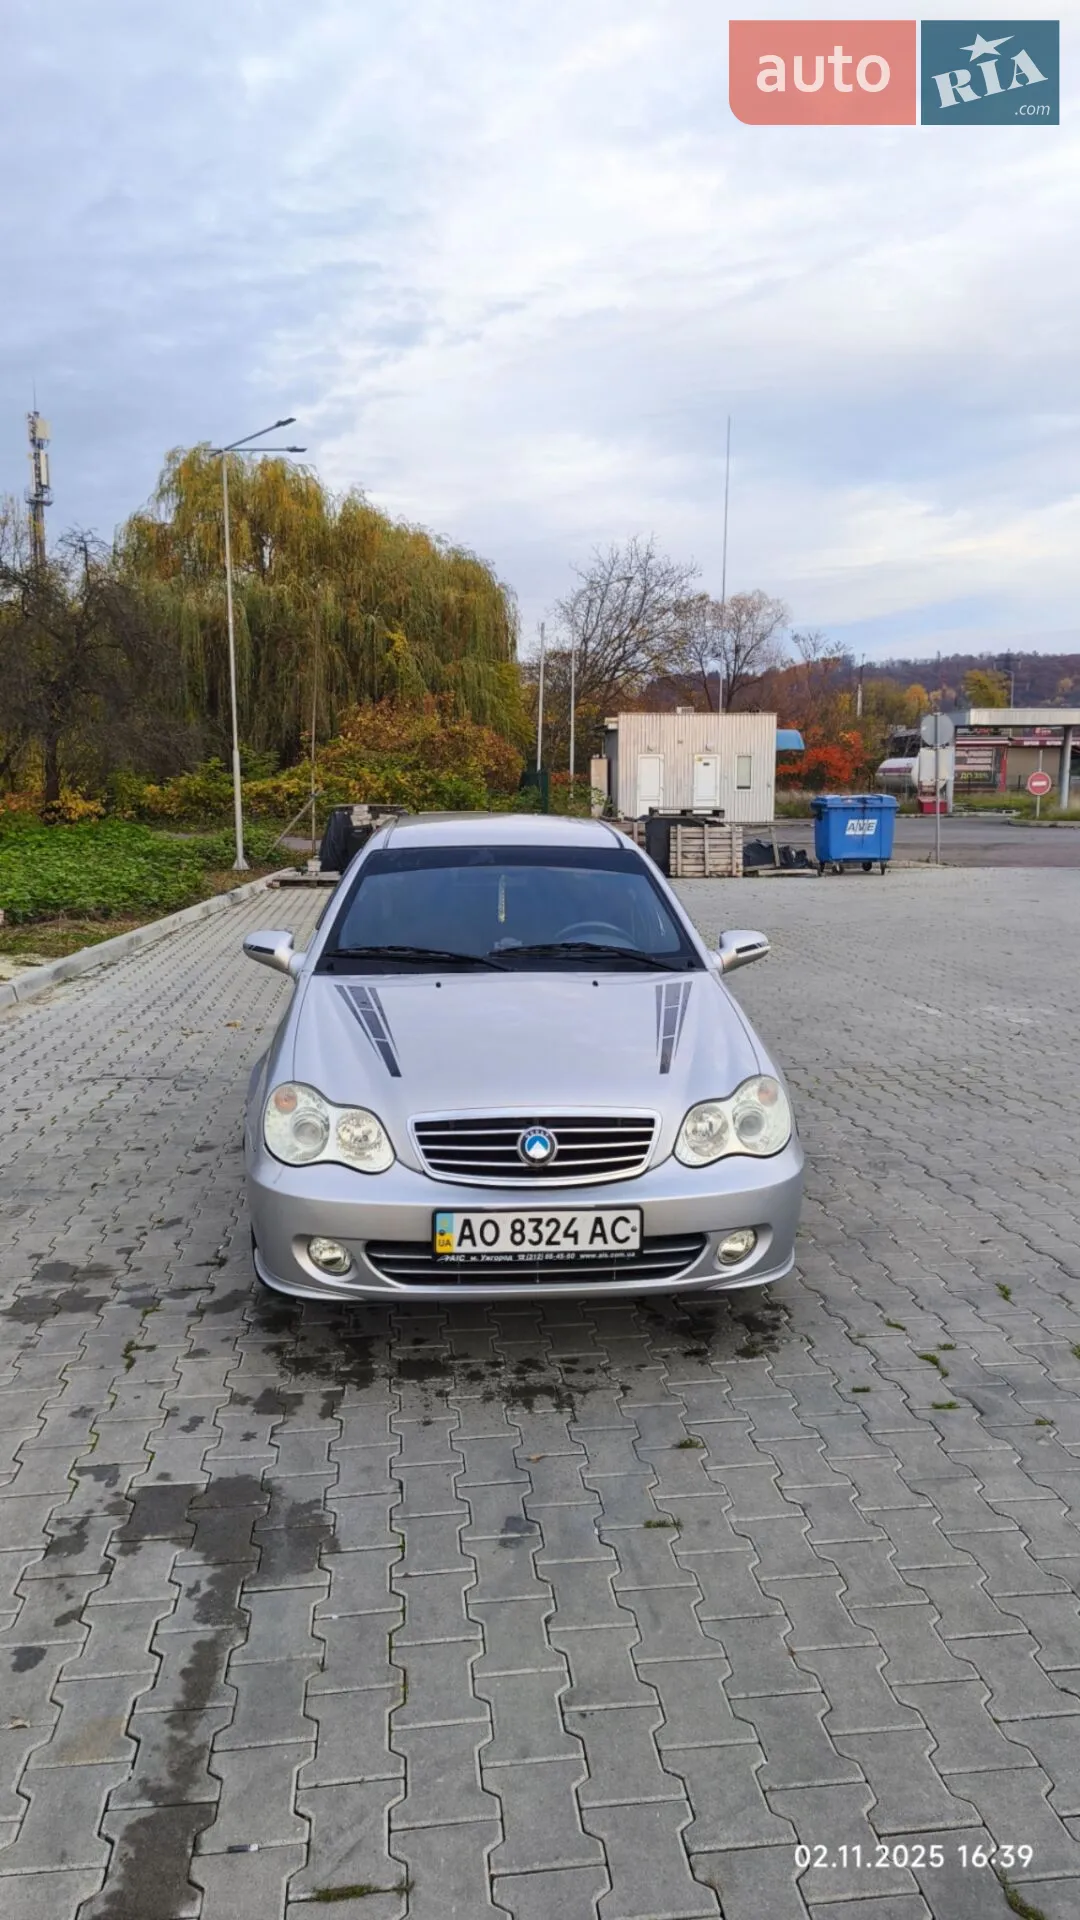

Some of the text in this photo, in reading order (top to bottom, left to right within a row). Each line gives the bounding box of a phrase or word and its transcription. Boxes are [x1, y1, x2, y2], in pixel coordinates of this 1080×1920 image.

[847, 821, 876, 833] AVE
[456, 1215, 631, 1247] AO 8324 AC
[438, 1239, 452, 1248] UA
